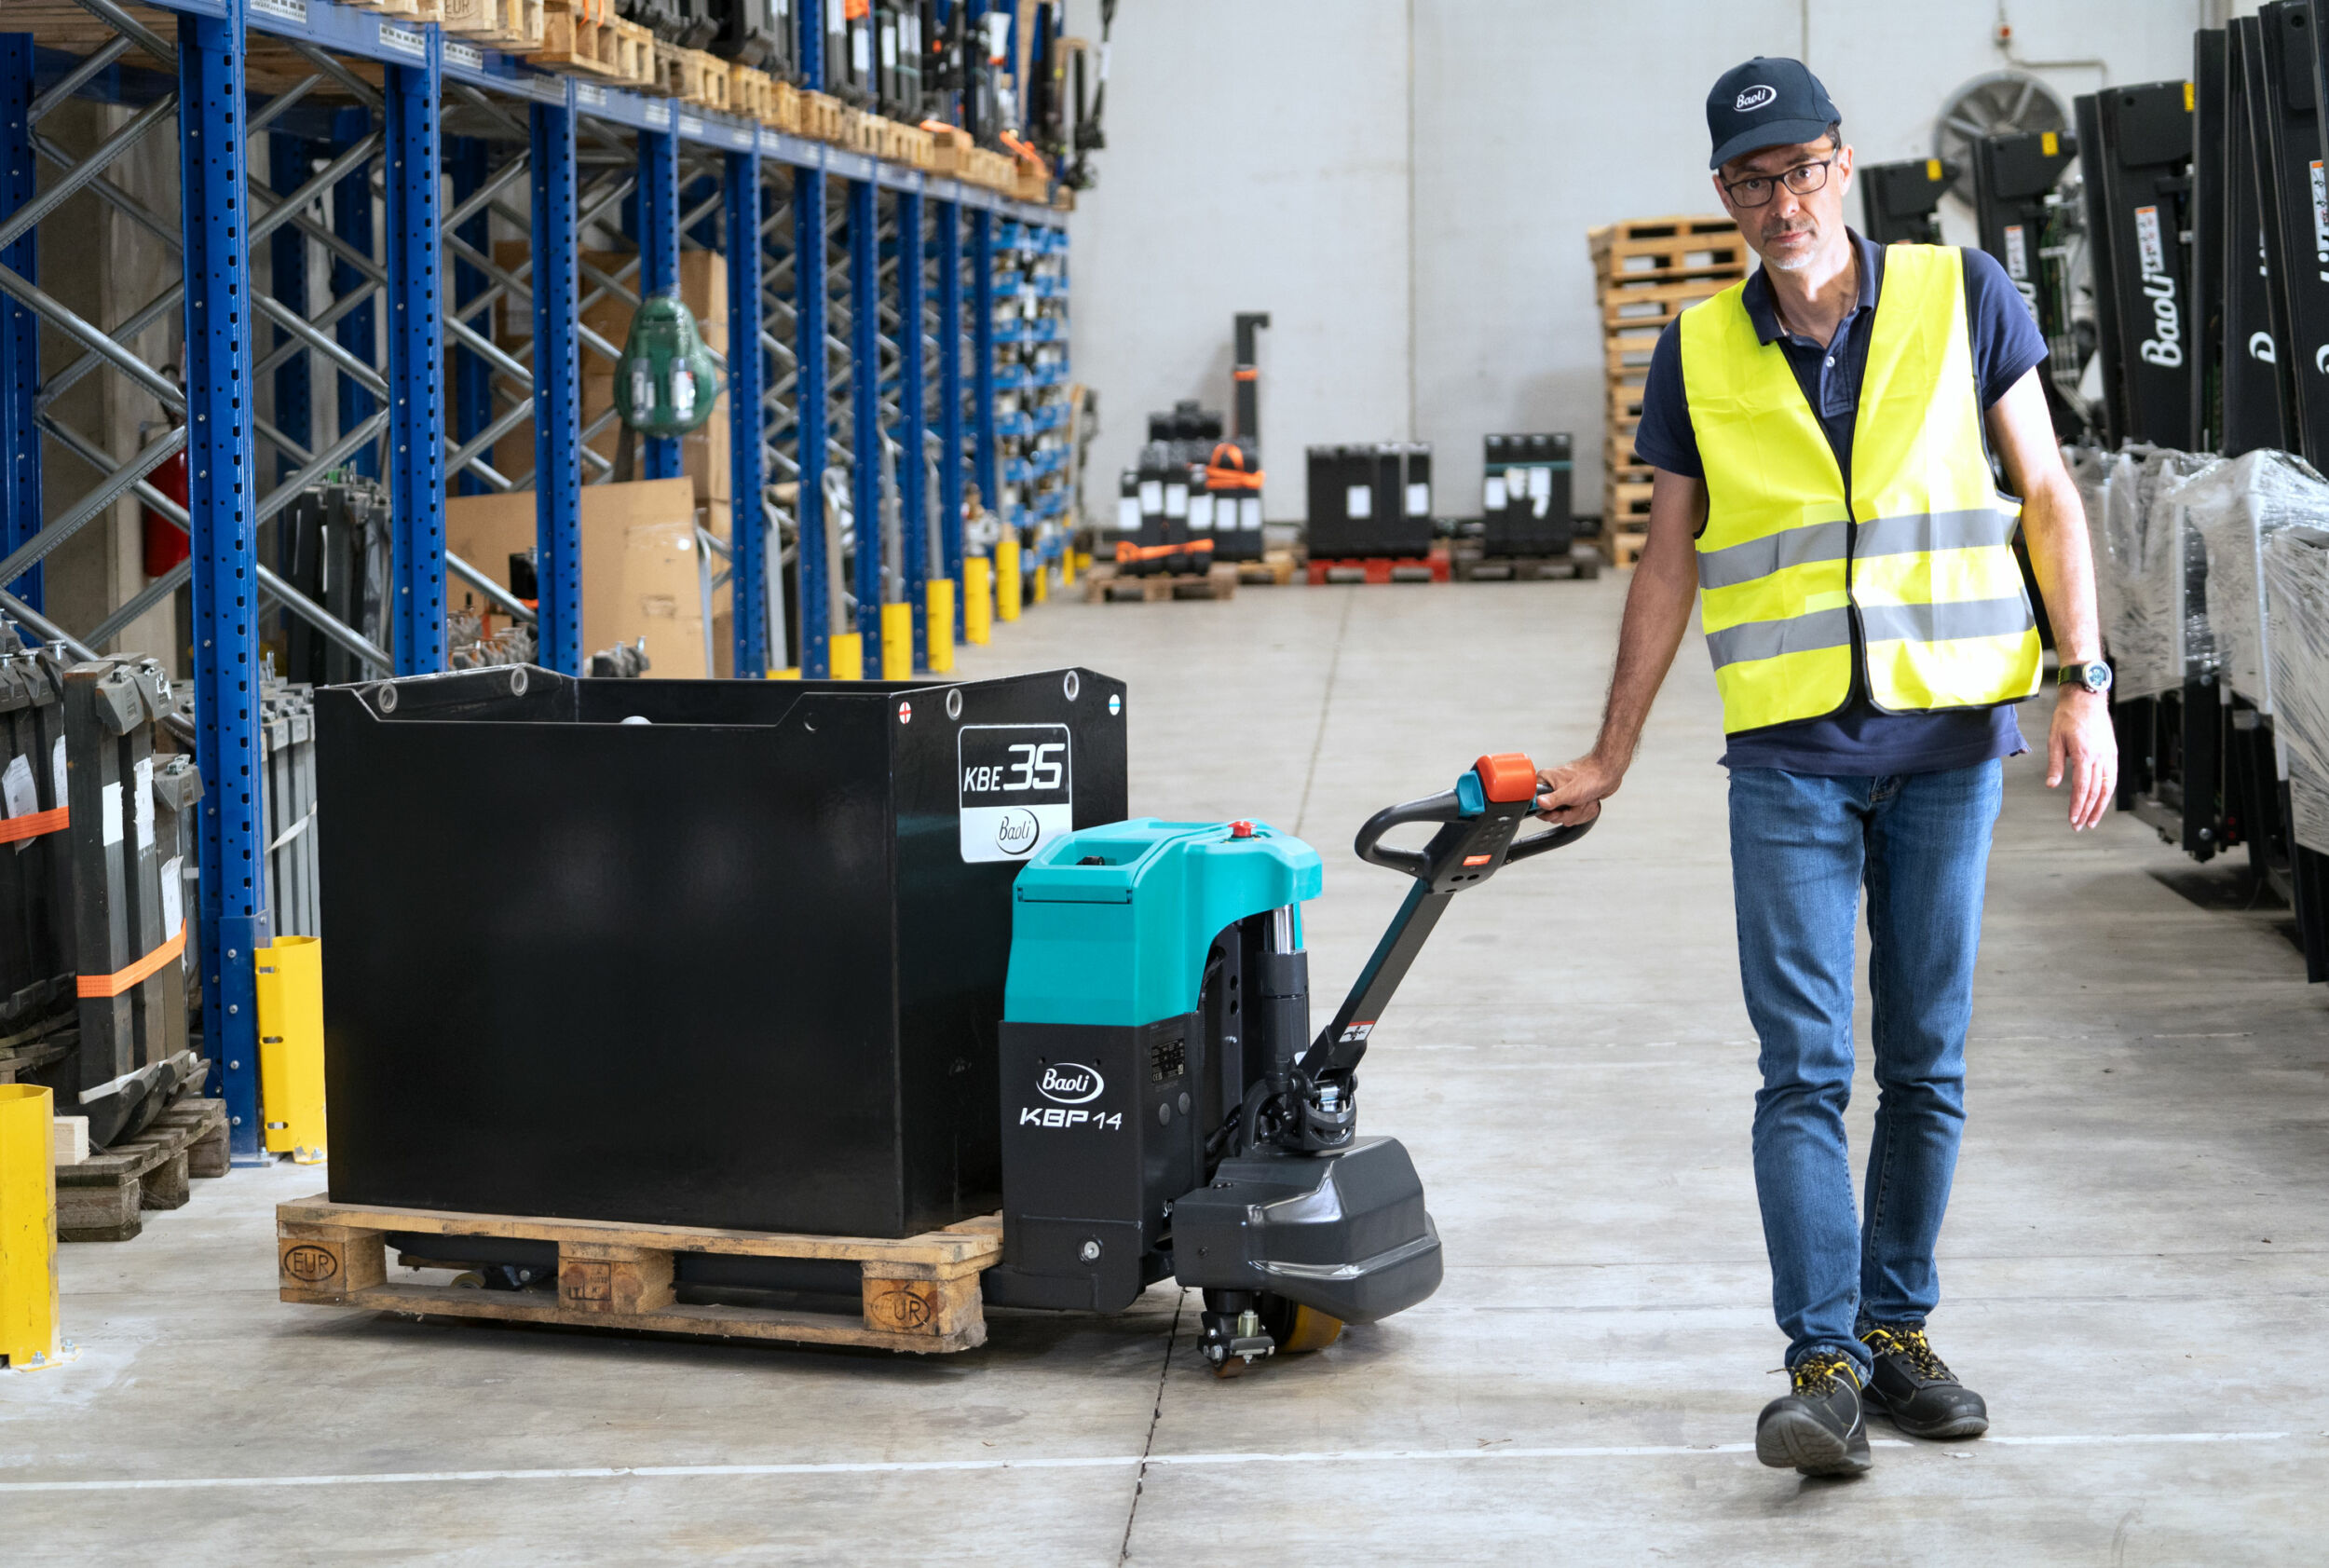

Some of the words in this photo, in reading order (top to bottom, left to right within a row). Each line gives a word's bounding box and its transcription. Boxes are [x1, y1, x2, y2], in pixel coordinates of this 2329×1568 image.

[1737, 89, 1766, 108] Baoli
[2141, 273, 2183, 368] Baoli
[963, 766, 1003, 792] KBE
[1003, 743, 1066, 791] 35
[999, 815, 1031, 840] Baoli
[1042, 1068, 1090, 1092] Baoli
[1020, 1107, 1089, 1128] KBP
[1093, 1111, 1123, 1131] 14
[293, 1251, 329, 1274] EUR
